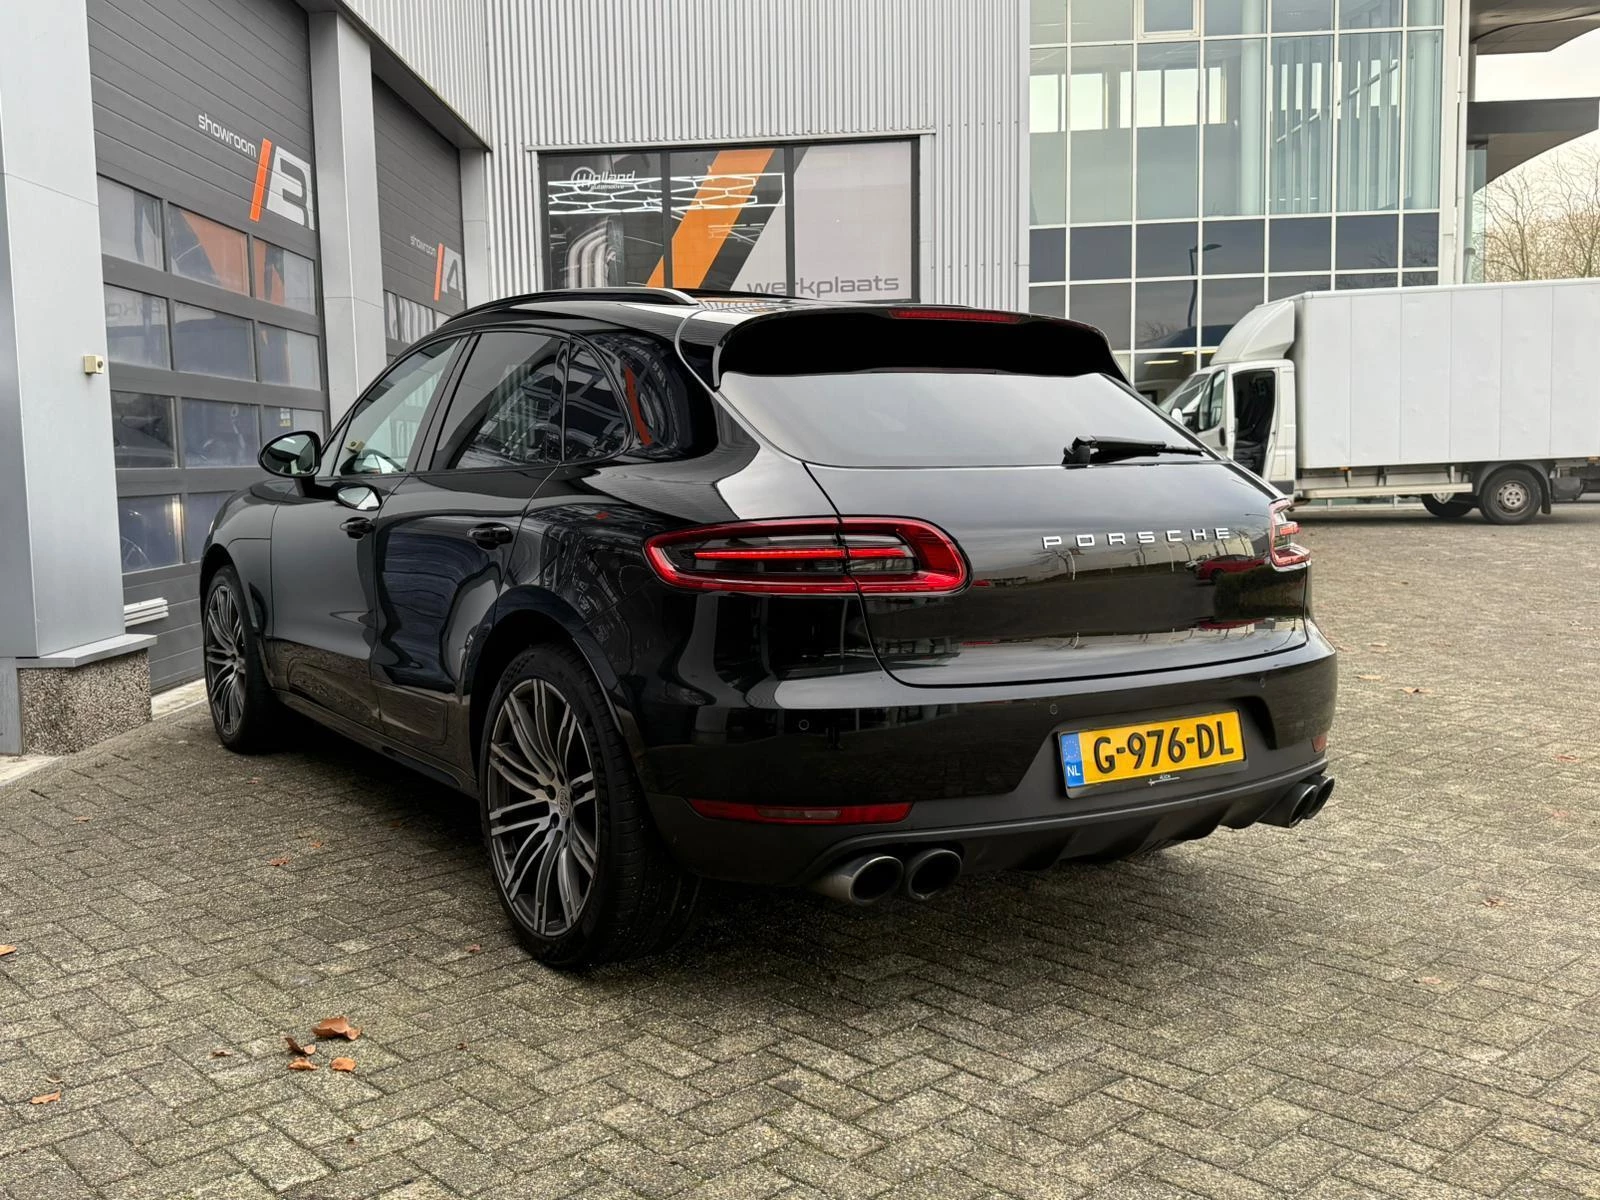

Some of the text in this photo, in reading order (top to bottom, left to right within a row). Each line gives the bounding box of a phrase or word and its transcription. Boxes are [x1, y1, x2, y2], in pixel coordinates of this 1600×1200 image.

[198, 113, 257, 159] showroom
[409, 235, 437, 258] showroom
[747, 275, 900, 298] wekplaats
[1042, 527, 1230, 550] PORSCHE
[1093, 721, 1234, 774] G-976-DL
[1067, 765, 1081, 777] NL
